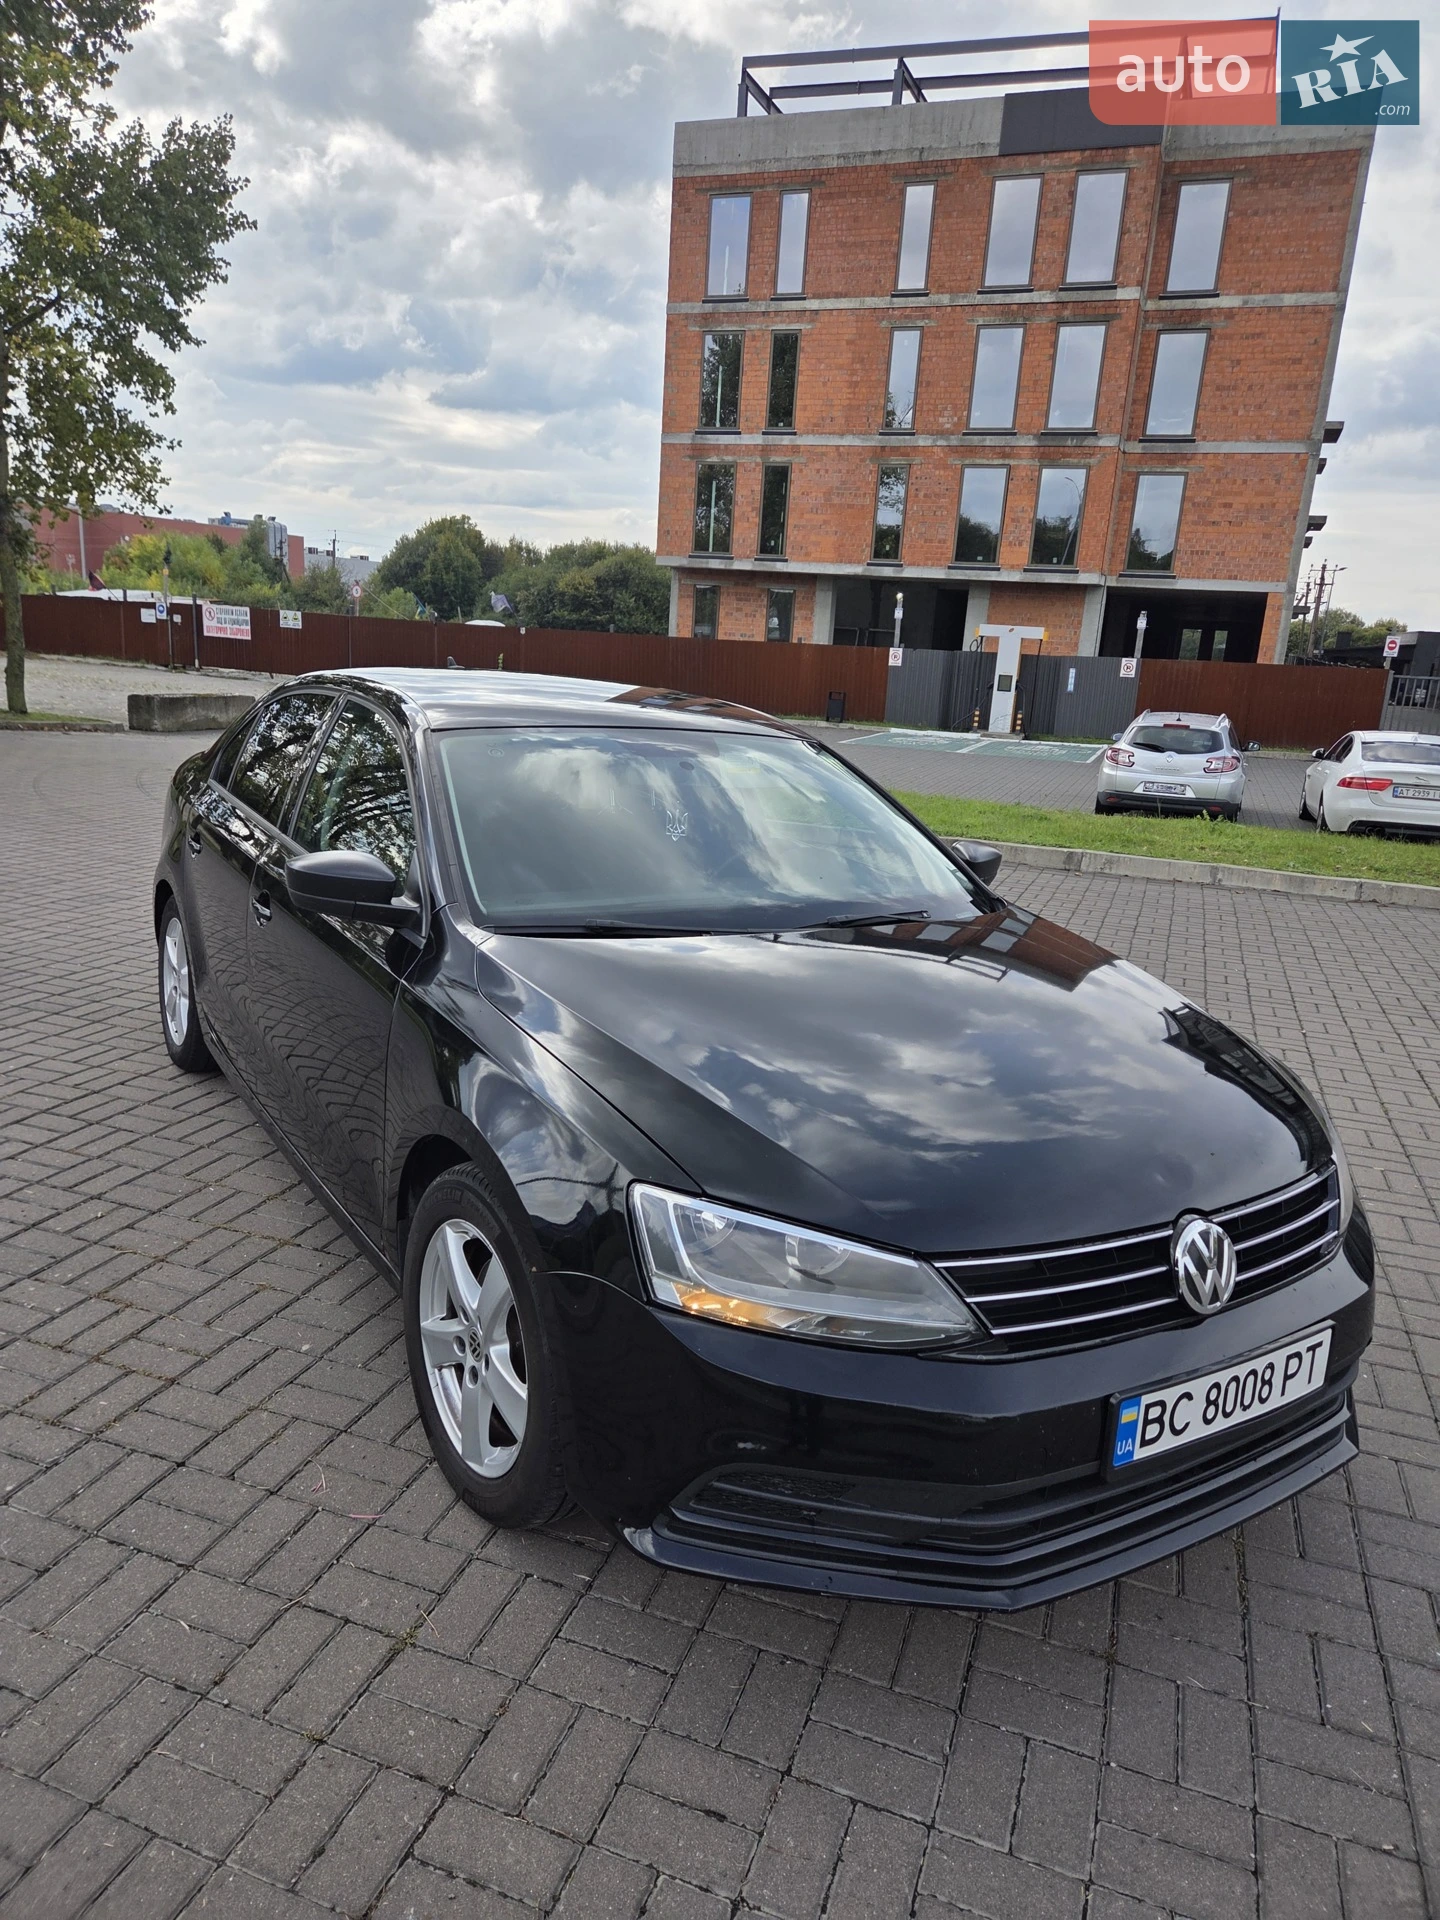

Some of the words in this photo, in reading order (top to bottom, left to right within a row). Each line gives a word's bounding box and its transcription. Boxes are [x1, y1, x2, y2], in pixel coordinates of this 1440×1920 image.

[1399, 788, 1410, 796] AT
[1139, 1391, 1194, 1449] BC
[1202, 1361, 1275, 1425] 8008
[1280, 1340, 1324, 1397] PT
[1116, 1437, 1133, 1456] UA
